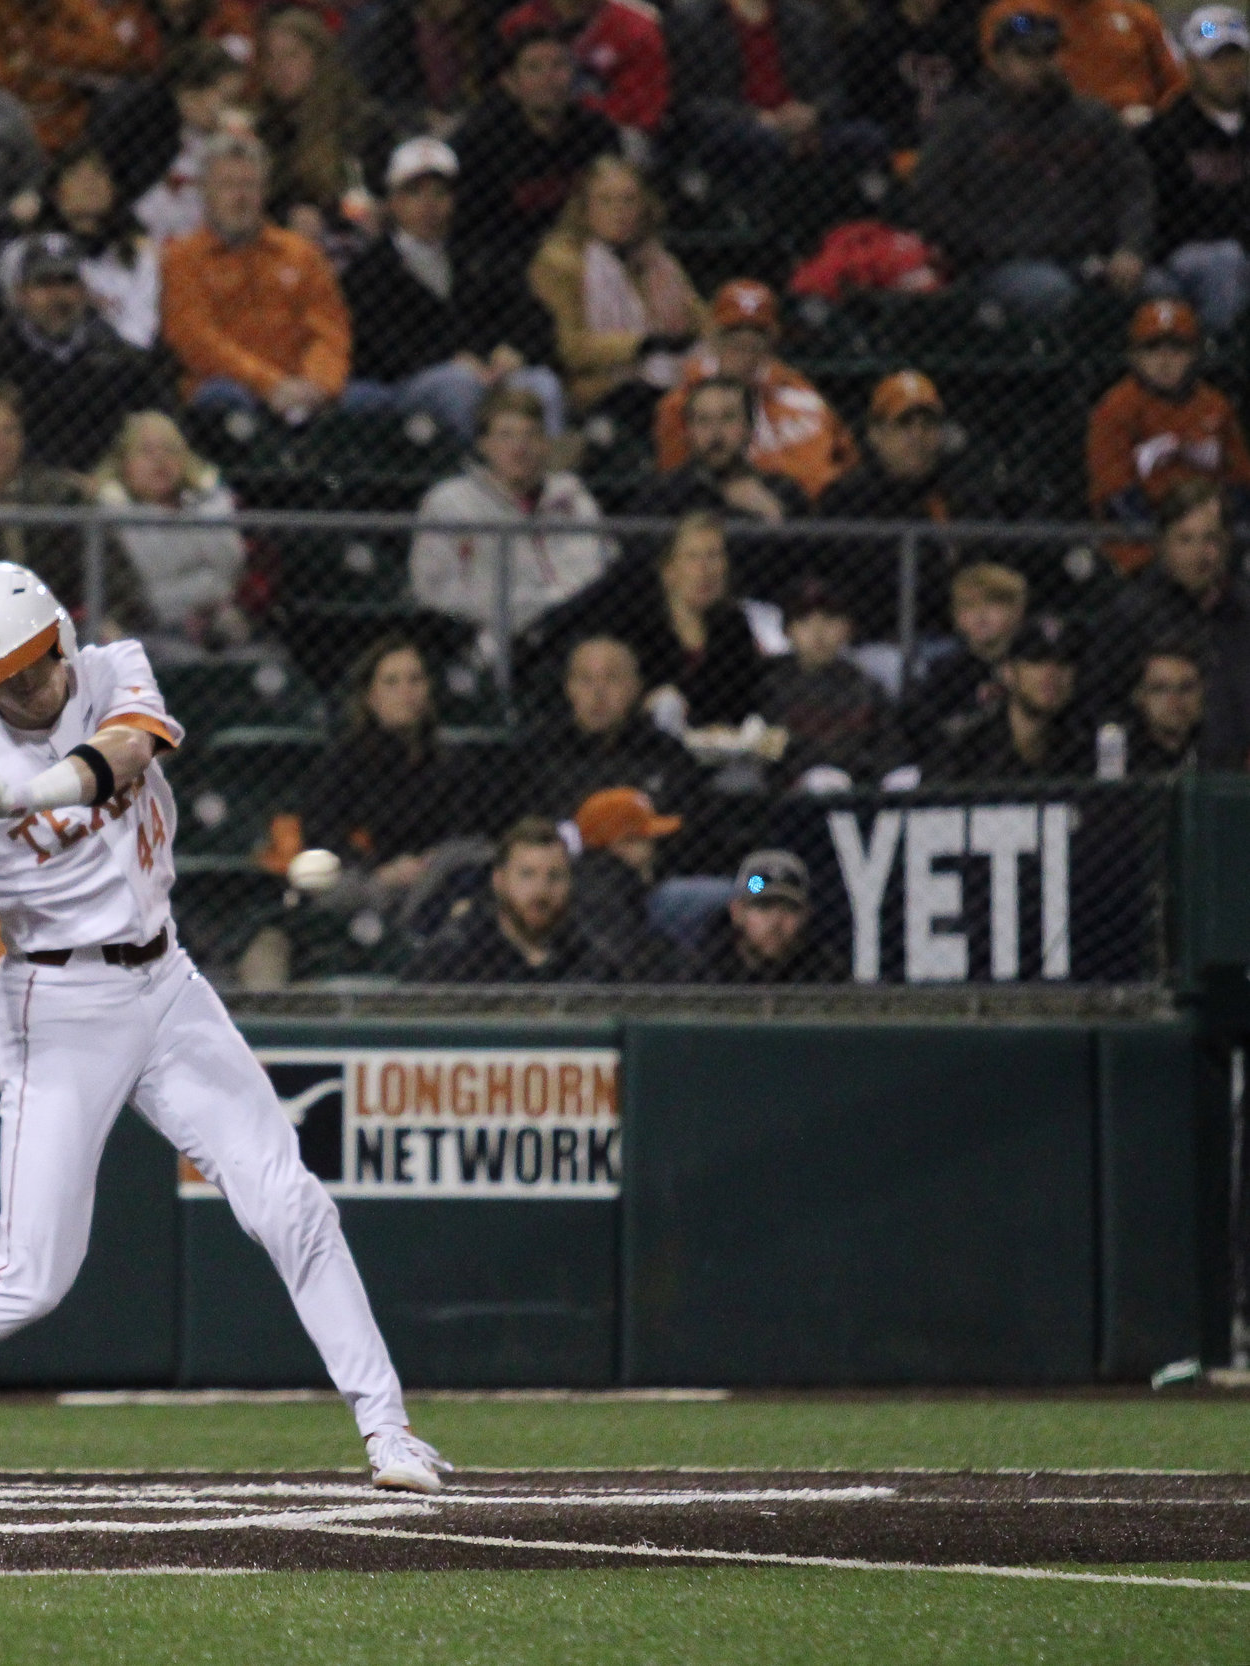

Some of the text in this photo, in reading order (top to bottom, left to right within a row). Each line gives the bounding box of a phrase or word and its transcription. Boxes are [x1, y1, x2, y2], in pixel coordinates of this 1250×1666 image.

[826, 802, 1071, 983] YETI
[355, 1062, 618, 1117] LONGHORN
[356, 1127, 620, 1184] NETWORK
